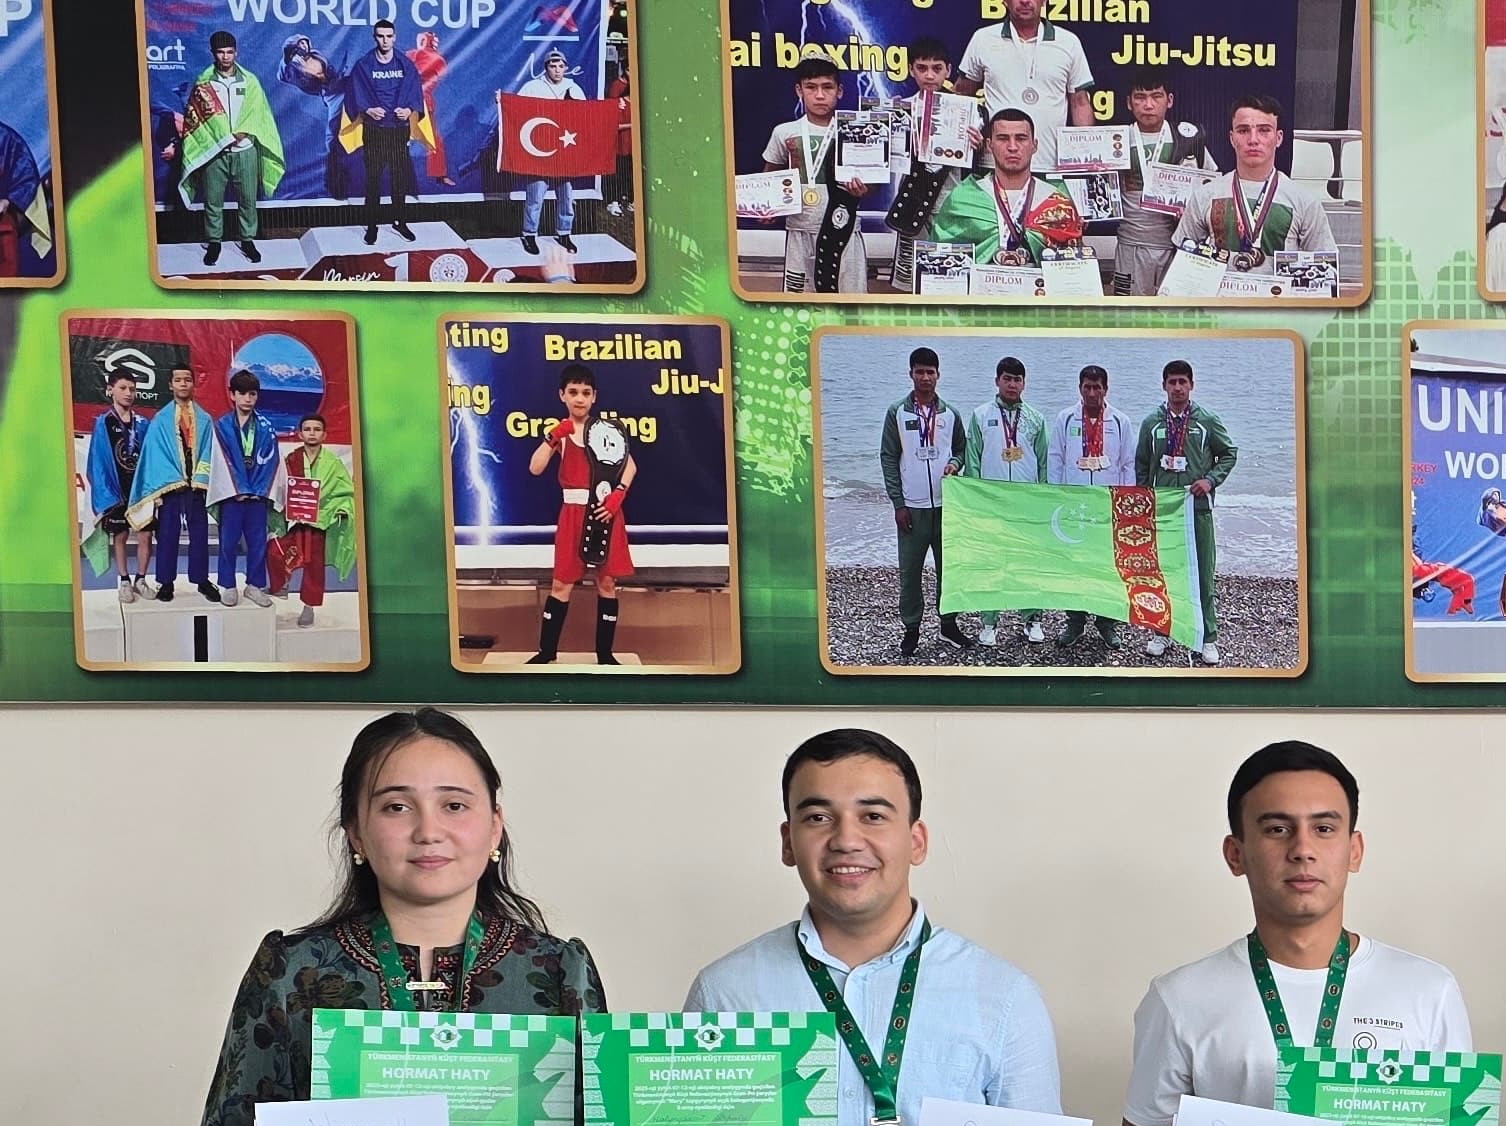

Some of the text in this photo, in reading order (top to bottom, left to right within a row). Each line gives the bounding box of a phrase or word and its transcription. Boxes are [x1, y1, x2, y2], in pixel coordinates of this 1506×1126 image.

[227, 0, 397, 27] WORLD
[411, 0, 496, 28] CUP
[981, 0, 1150, 23] Bzilian
[1111, 34, 1276, 66] Jiu-Jitsu
[984, 275, 1023, 286] DIPLOM
[544, 333, 682, 361] Brazilian
[382, 1067, 491, 1081] HORMAT HATY
[649, 1068, 754, 1081] HORMAT HATY
[1333, 1098, 1427, 1113] HORMAT HATY
